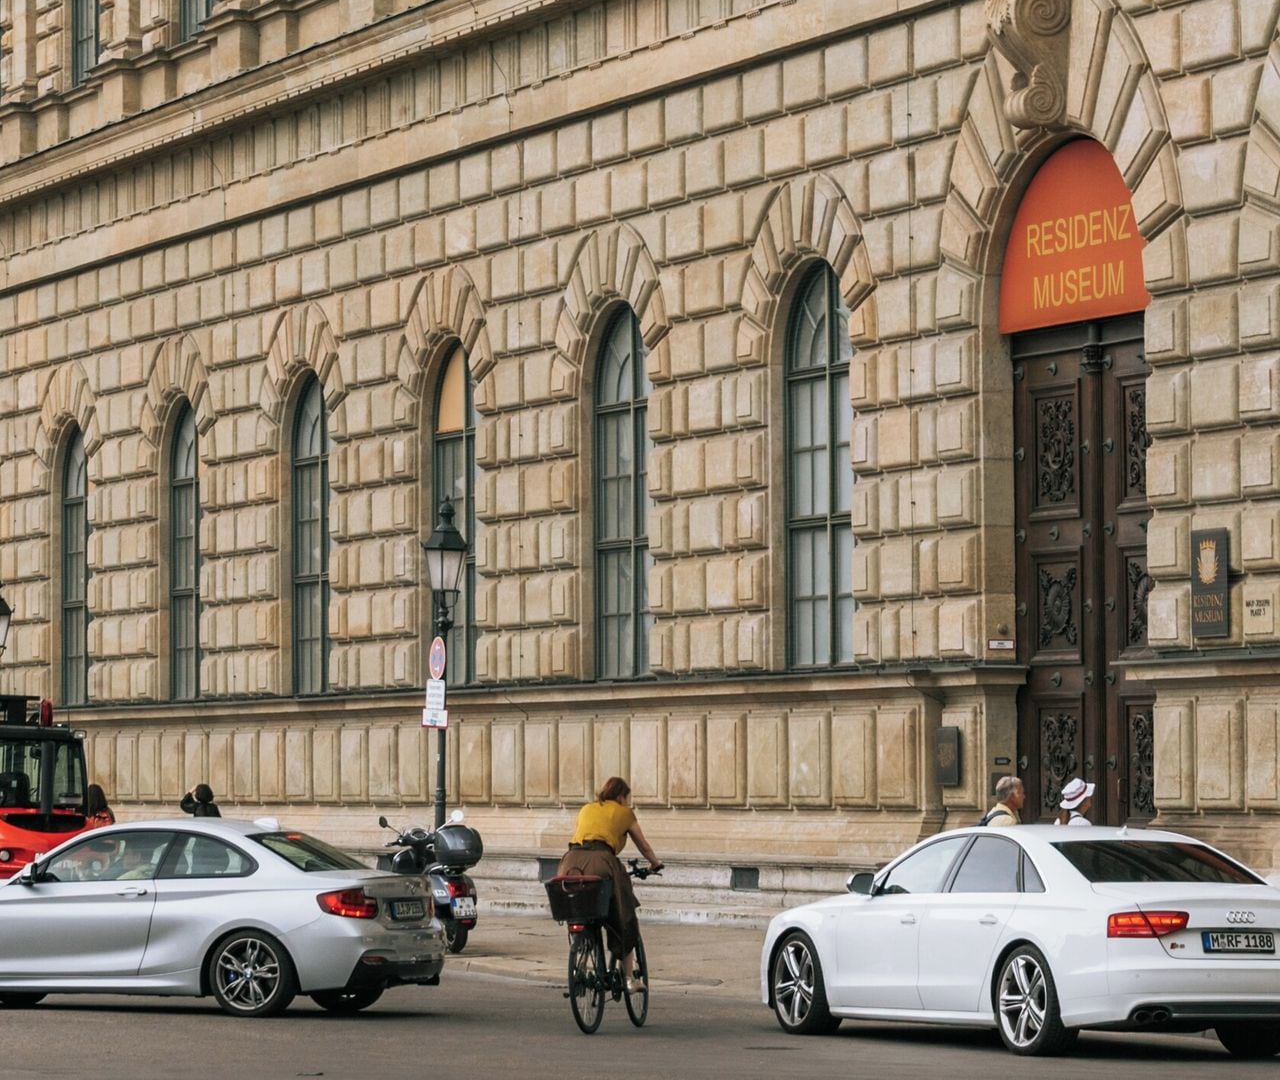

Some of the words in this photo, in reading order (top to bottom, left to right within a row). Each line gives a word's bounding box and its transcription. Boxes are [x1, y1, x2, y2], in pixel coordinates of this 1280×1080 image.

[1026, 204, 1132, 258] RESIDENZ
[1033, 260, 1124, 310] MUSEUM
[1211, 934, 1220, 948] M
[1227, 934, 1242, 948] RF
[1244, 934, 1273, 949] 1188
